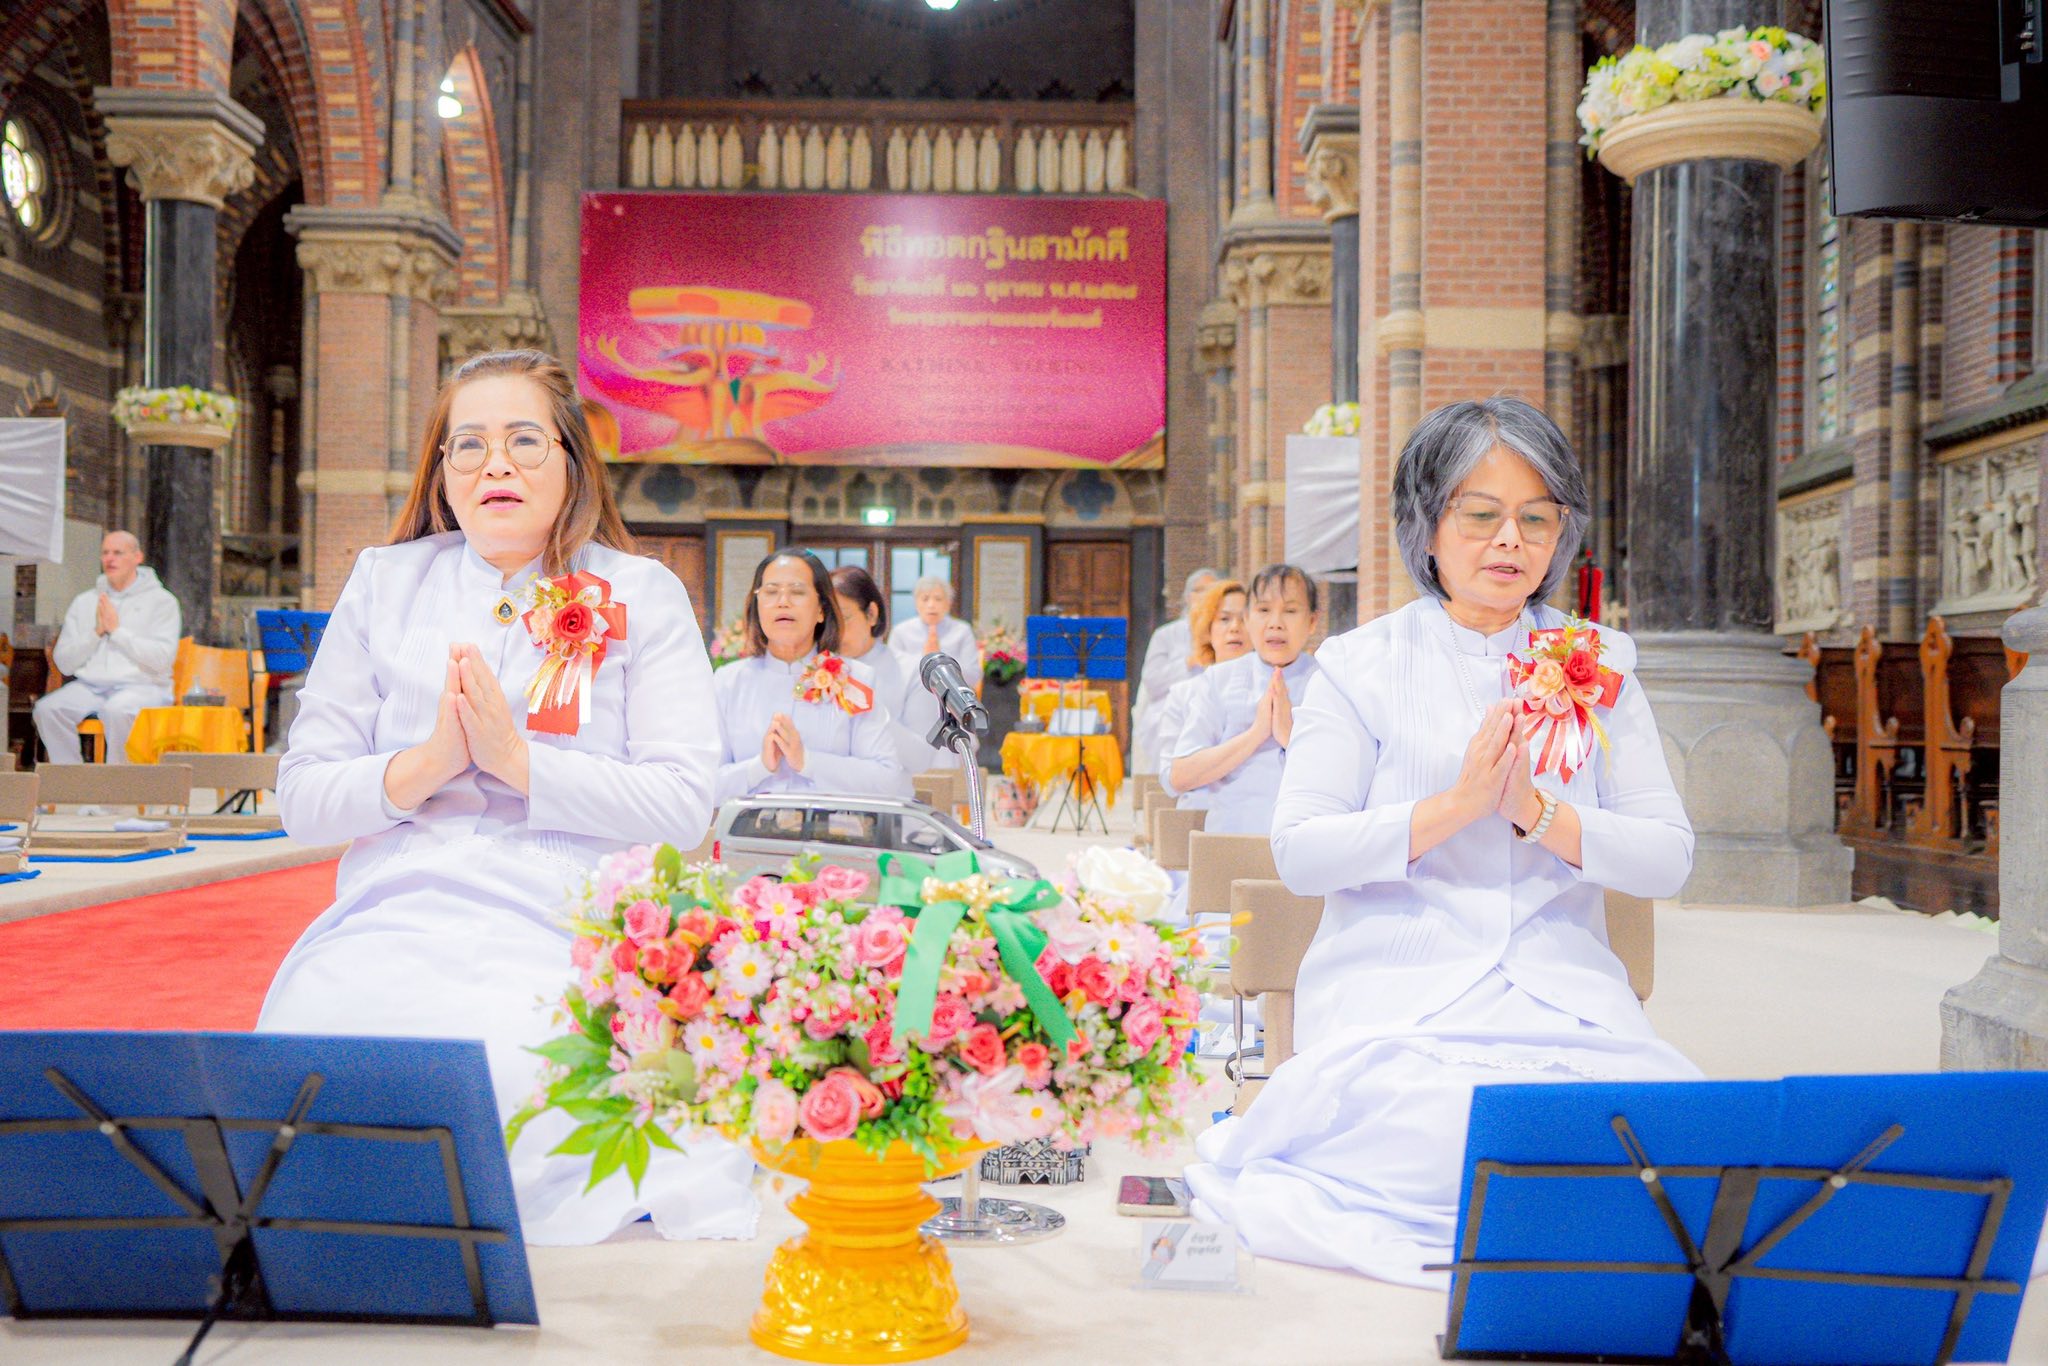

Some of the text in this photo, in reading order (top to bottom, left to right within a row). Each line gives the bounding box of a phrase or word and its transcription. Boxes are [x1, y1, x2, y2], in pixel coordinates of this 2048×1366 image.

[859, 225, 1129, 270] พิธีทอดกฐินสามัคคี
